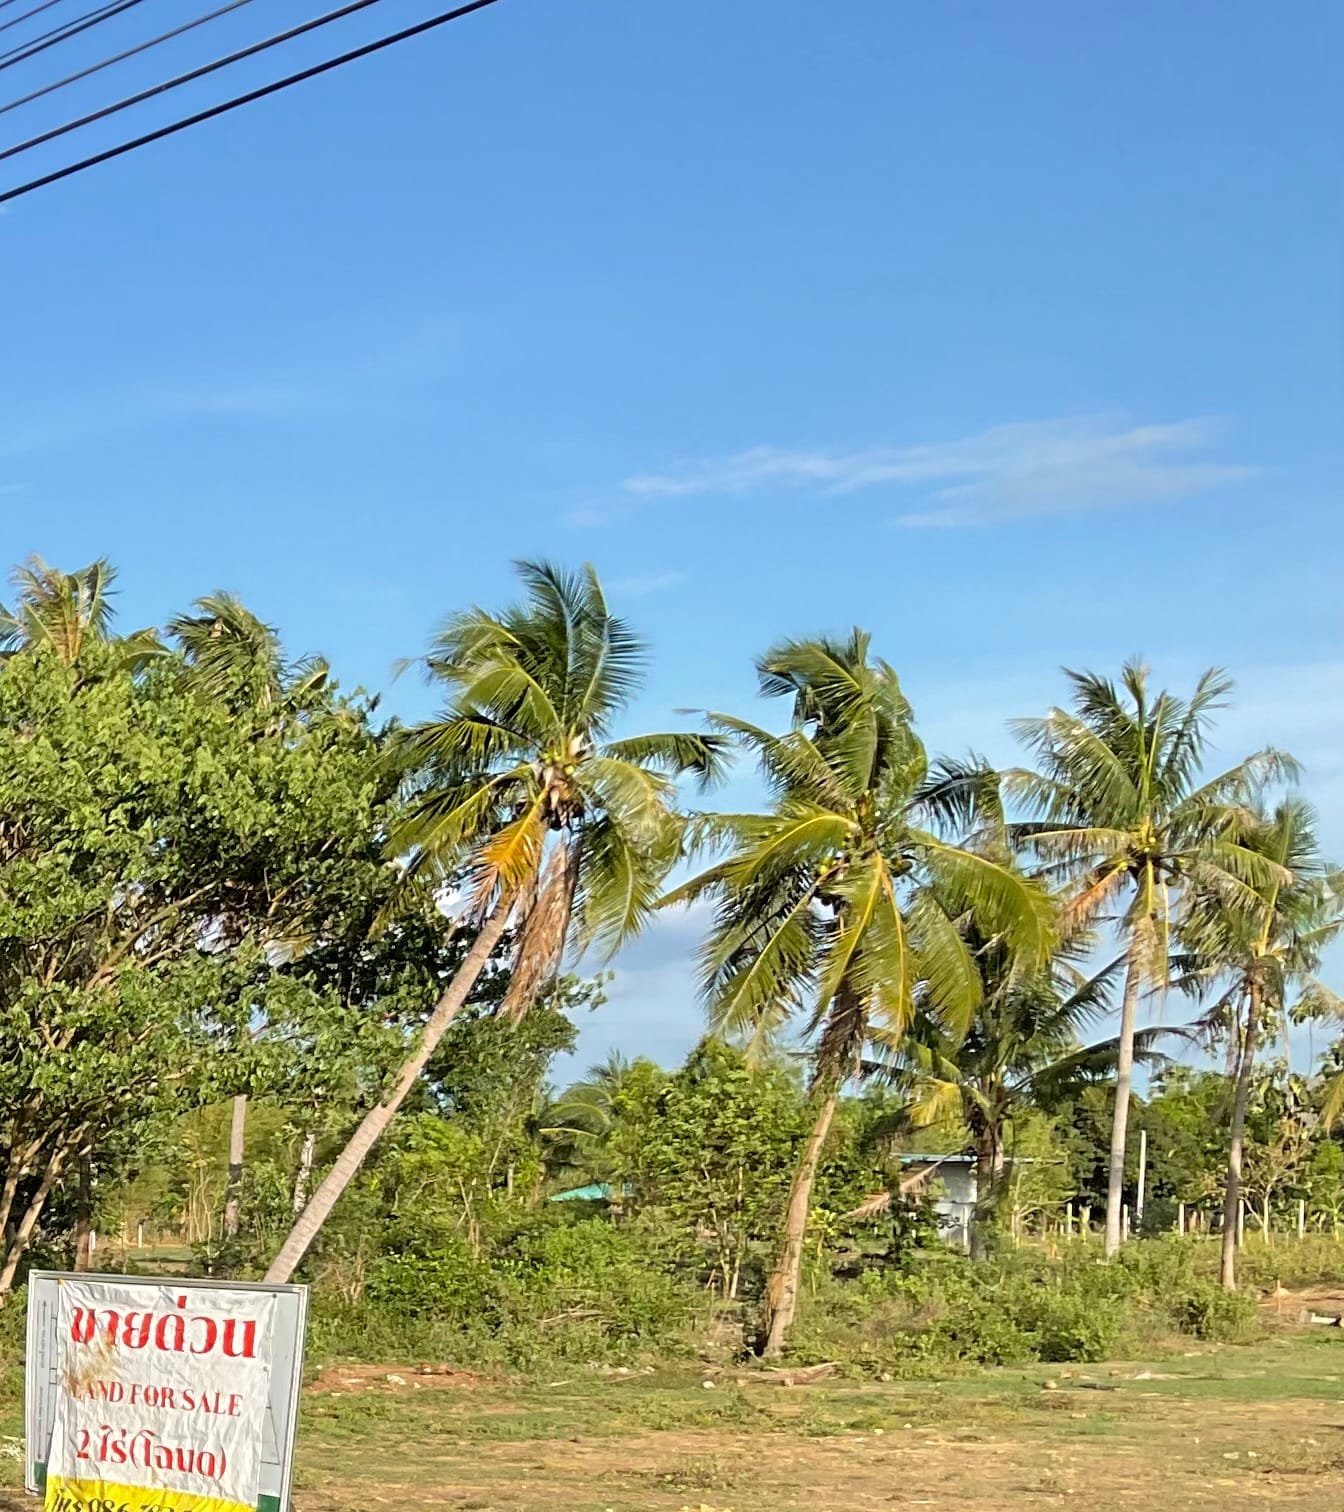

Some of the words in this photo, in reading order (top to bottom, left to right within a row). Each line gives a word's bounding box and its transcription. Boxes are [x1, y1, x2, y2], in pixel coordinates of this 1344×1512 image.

[70, 1295, 257, 1359] ขายด่วน
[72, 1379, 124, 1403] LAND
[129, 1383, 176, 1409] FOR
[182, 1388, 244, 1417] SALE
[76, 1428, 91, 1460] 2
